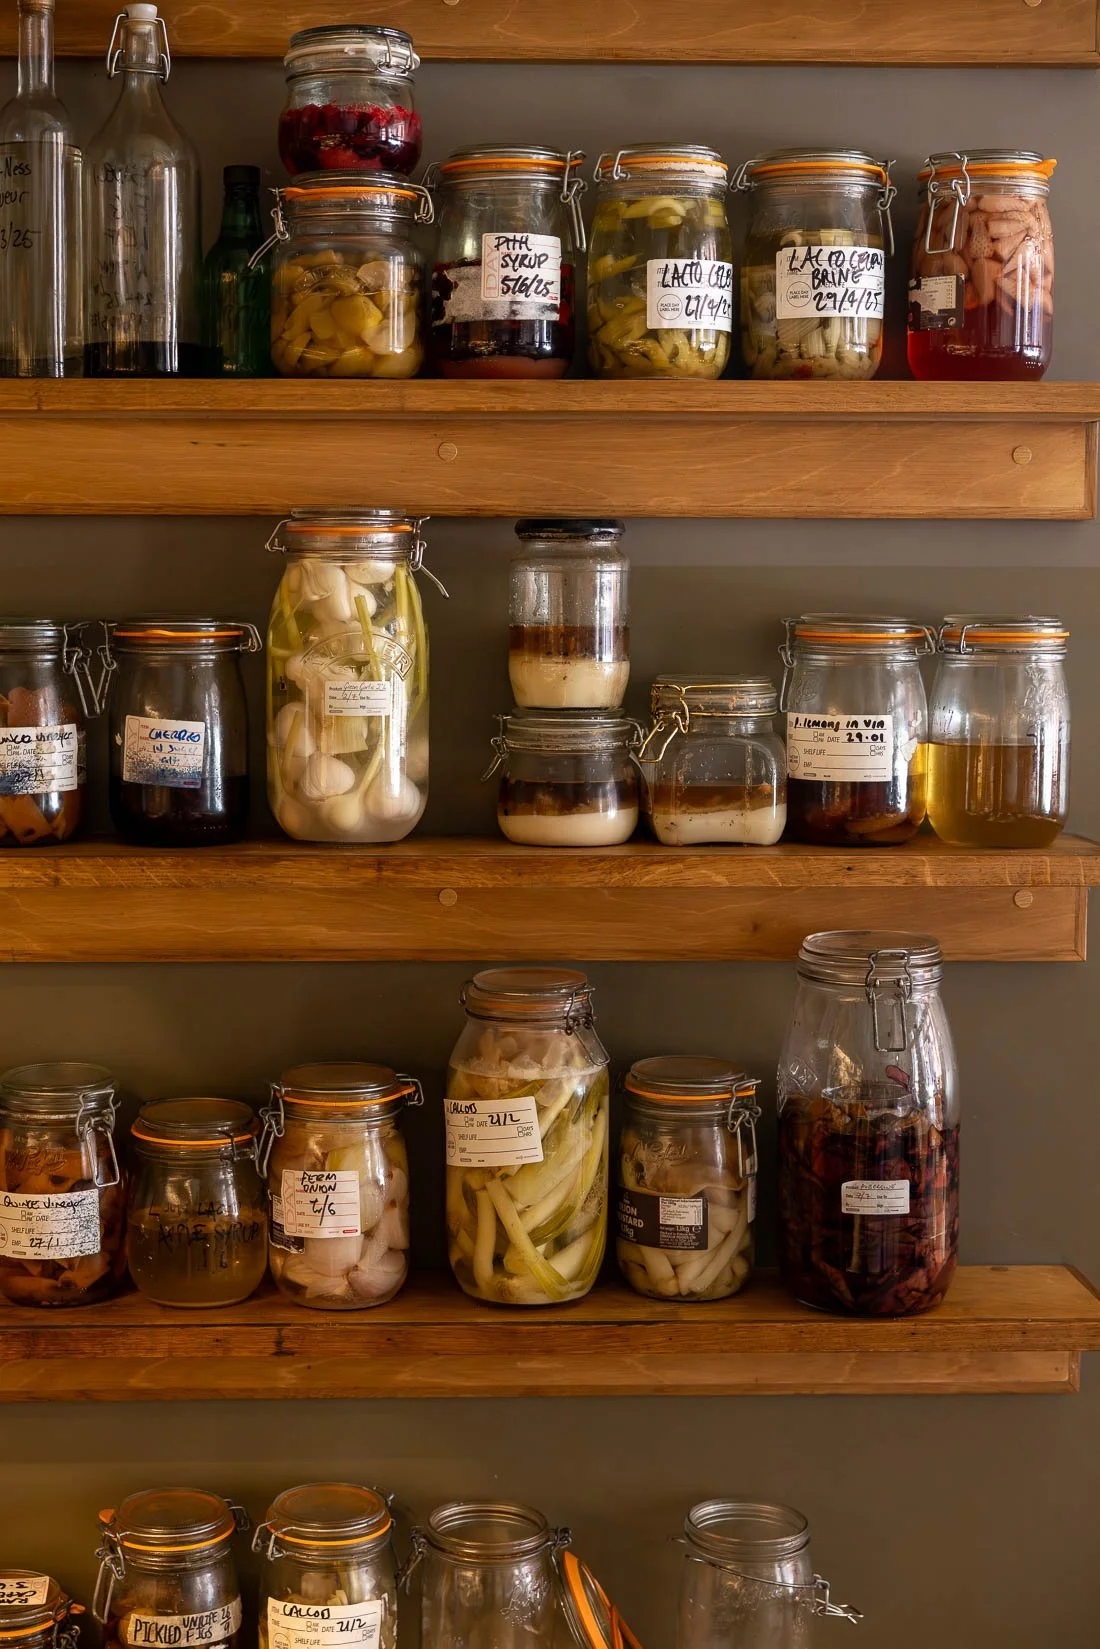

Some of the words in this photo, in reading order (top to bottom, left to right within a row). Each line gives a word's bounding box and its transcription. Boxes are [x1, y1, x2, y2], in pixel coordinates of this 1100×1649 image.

[501, 253, 549, 272] SYRUP
[789, 247, 846, 272] LACTO
[501, 274, 554, 298] 5/6/25
[661, 261, 703, 288] LACTO
[812, 267, 863, 290] BRINE
[813, 288, 882, 315] 29/4/25
[303, 1182, 337, 1194] ONION
[134, 1618, 181, 1645] PICKLED
[182, 1611, 218, 1630] UNRIPE
[186, 1626, 213, 1643] FIGS
[294, 1637, 309, 1645] SHELF
[309, 1638, 320, 1646] LIFE
